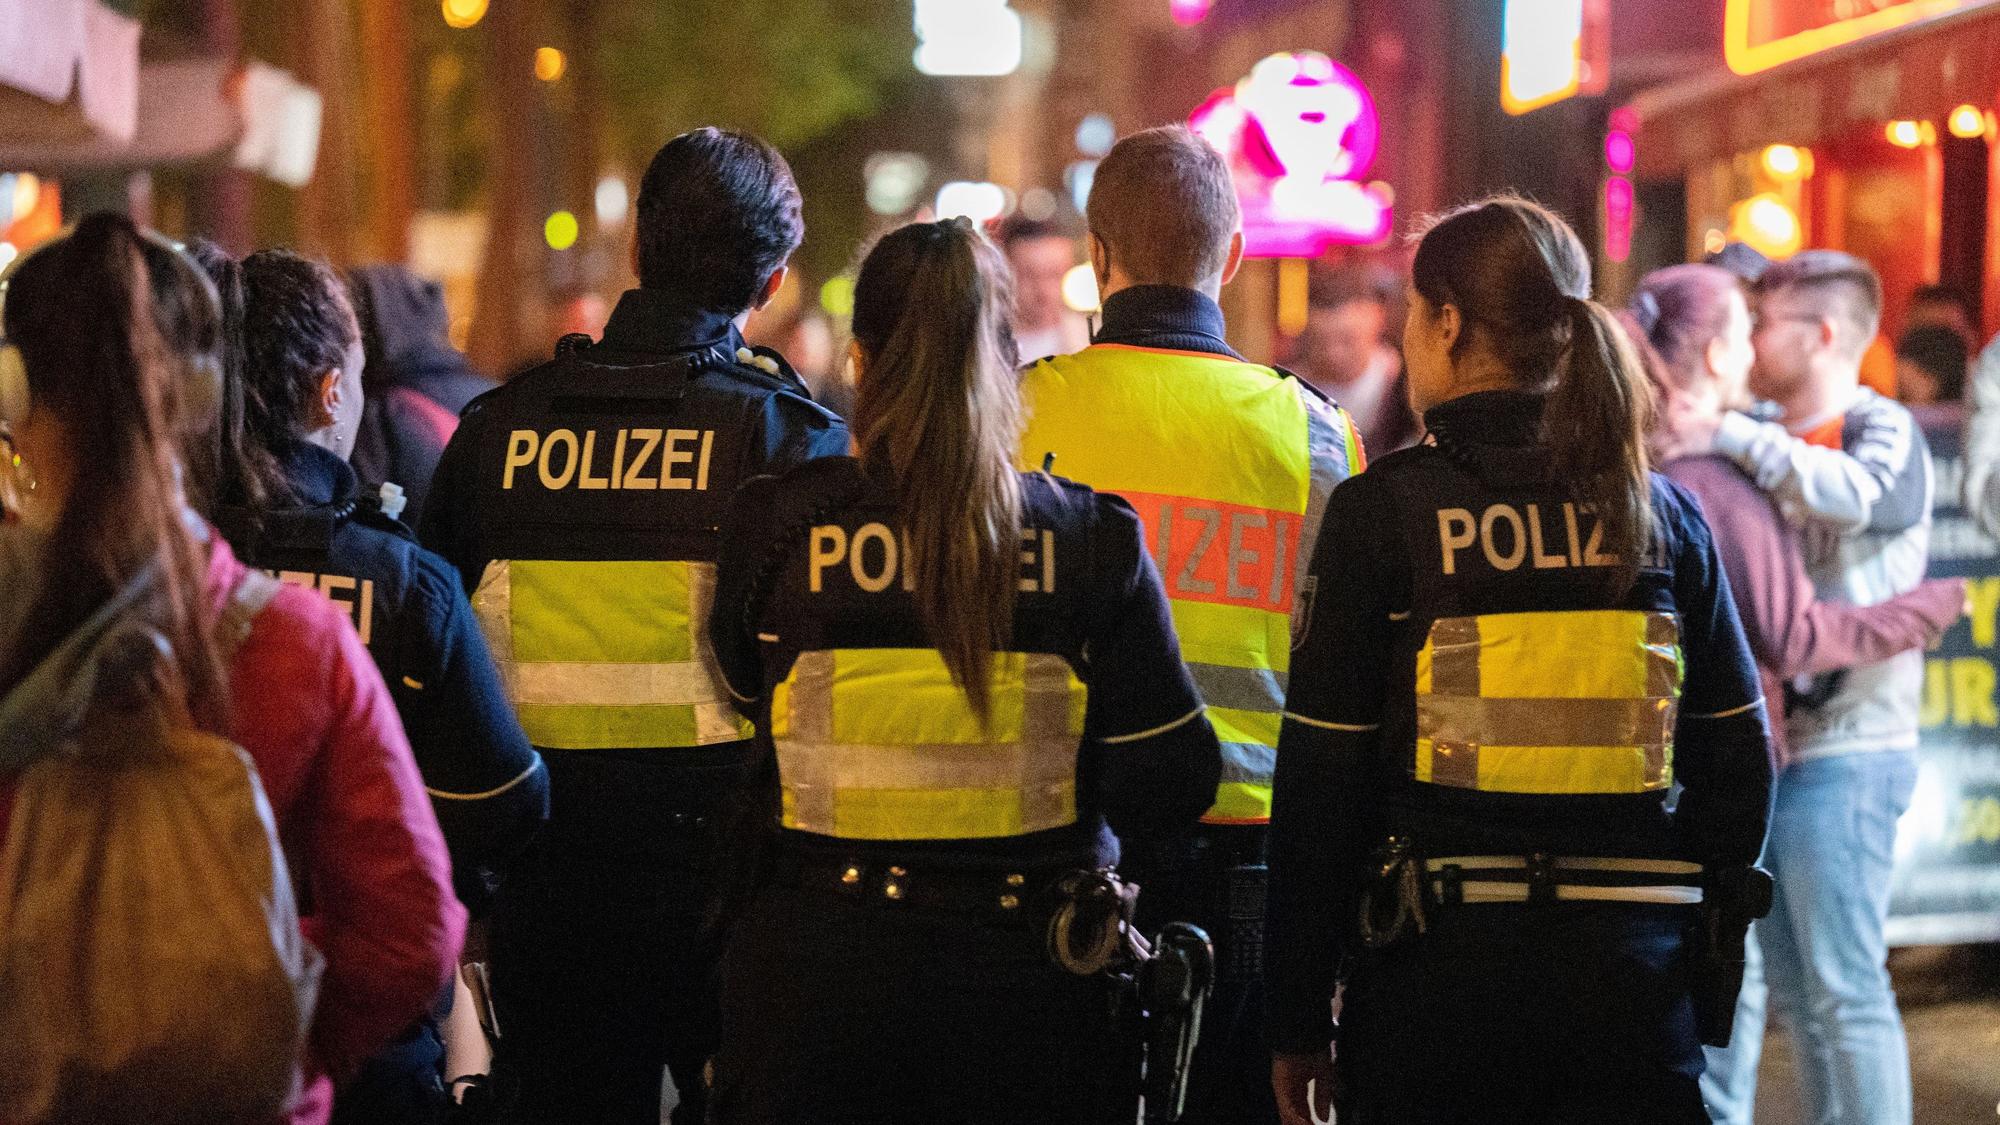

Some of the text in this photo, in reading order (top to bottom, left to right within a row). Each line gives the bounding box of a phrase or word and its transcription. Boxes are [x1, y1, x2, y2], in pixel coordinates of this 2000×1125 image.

[503, 428, 715, 490] POLIZEI
[809, 522, 1055, 593] POEI
[1436, 502, 1665, 575] POLIZ
